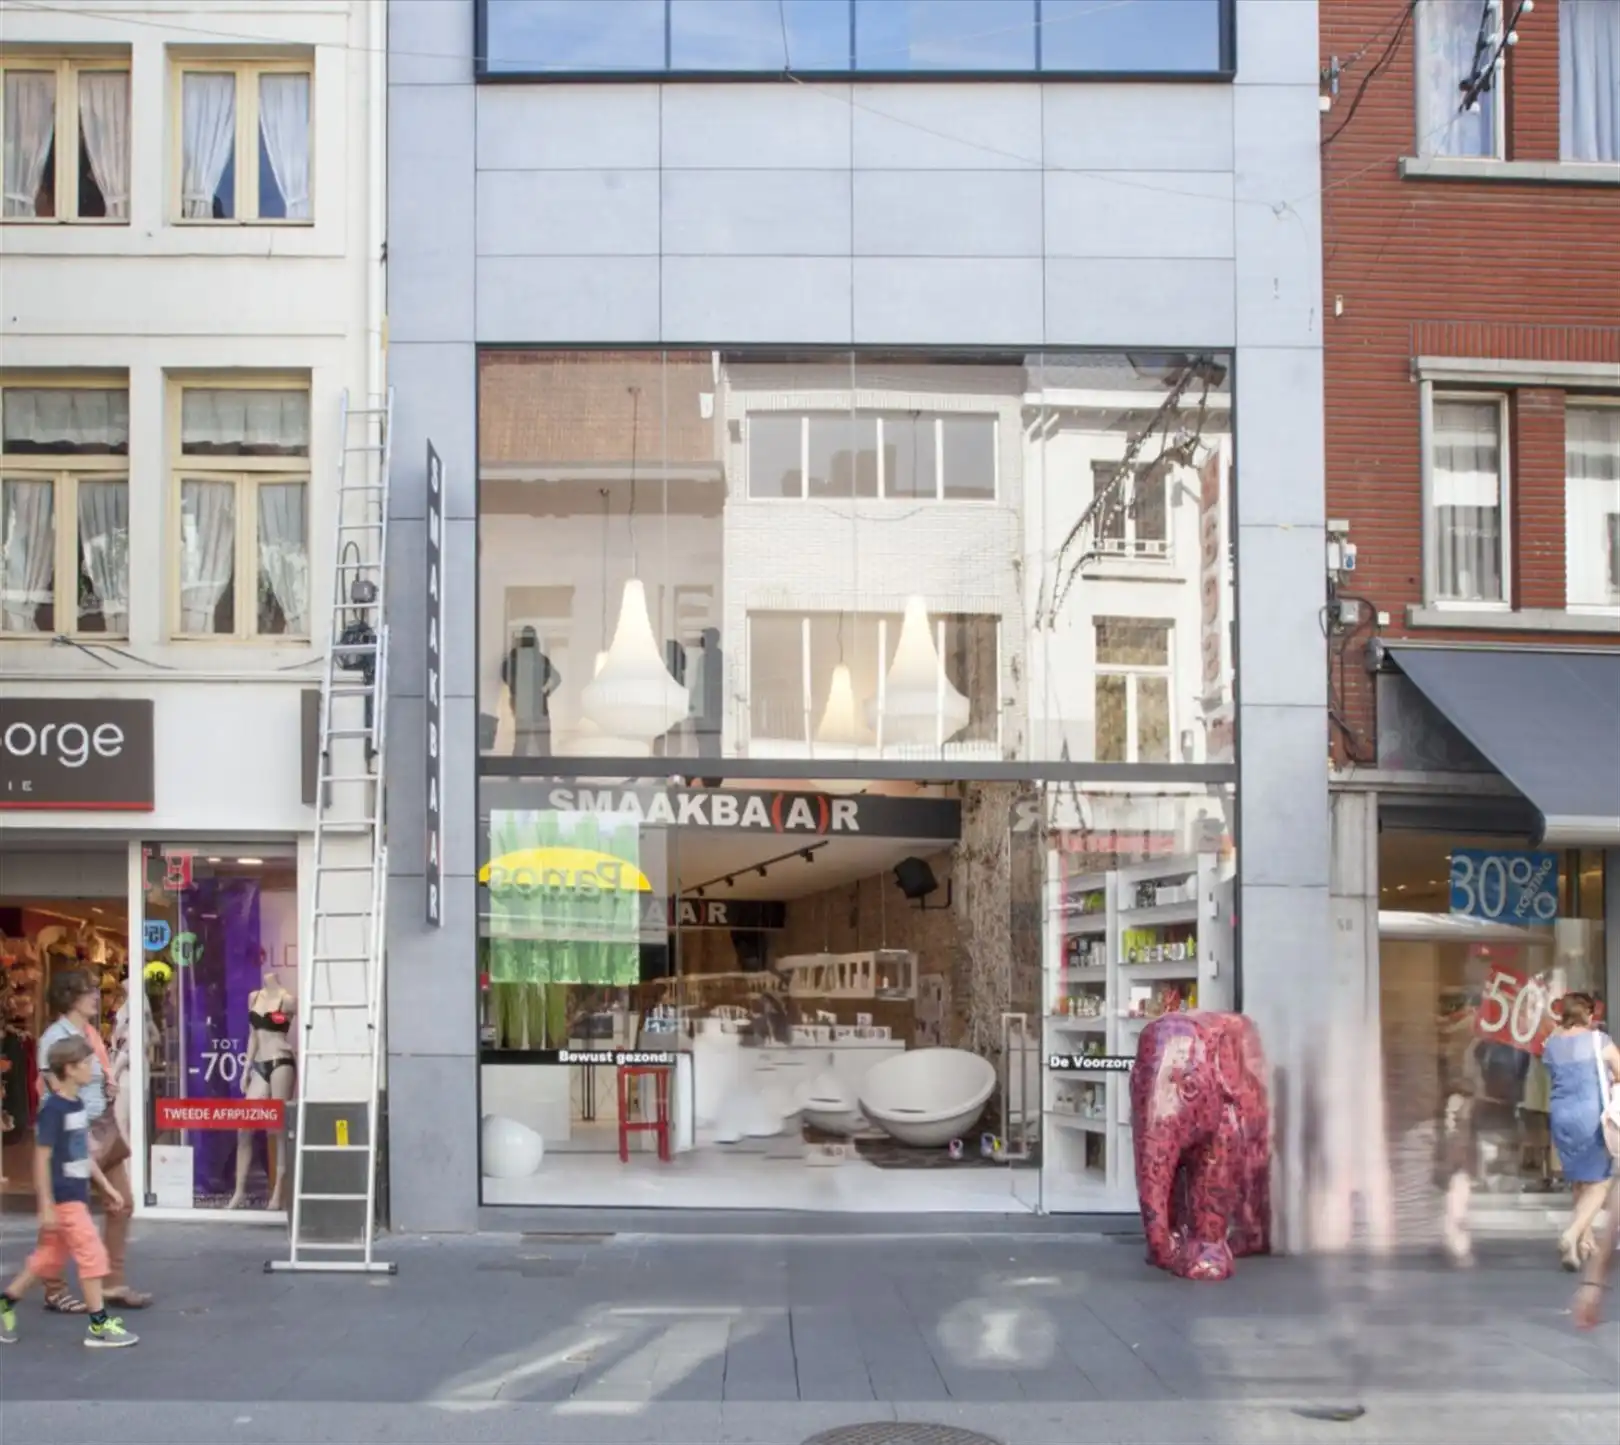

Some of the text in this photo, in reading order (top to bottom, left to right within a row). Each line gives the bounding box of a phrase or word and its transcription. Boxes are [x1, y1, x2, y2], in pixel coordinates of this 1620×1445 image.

[0, 721, 125, 768] orge
[548, 788, 860, 835] SMAAKBA(A)R
[211, 1038, 240, 1050] TOT
[558, 1050, 613, 1063] Bewust
[1050, 1056, 1070, 1068] De
[163, 1107, 210, 1121] TWEEDE
